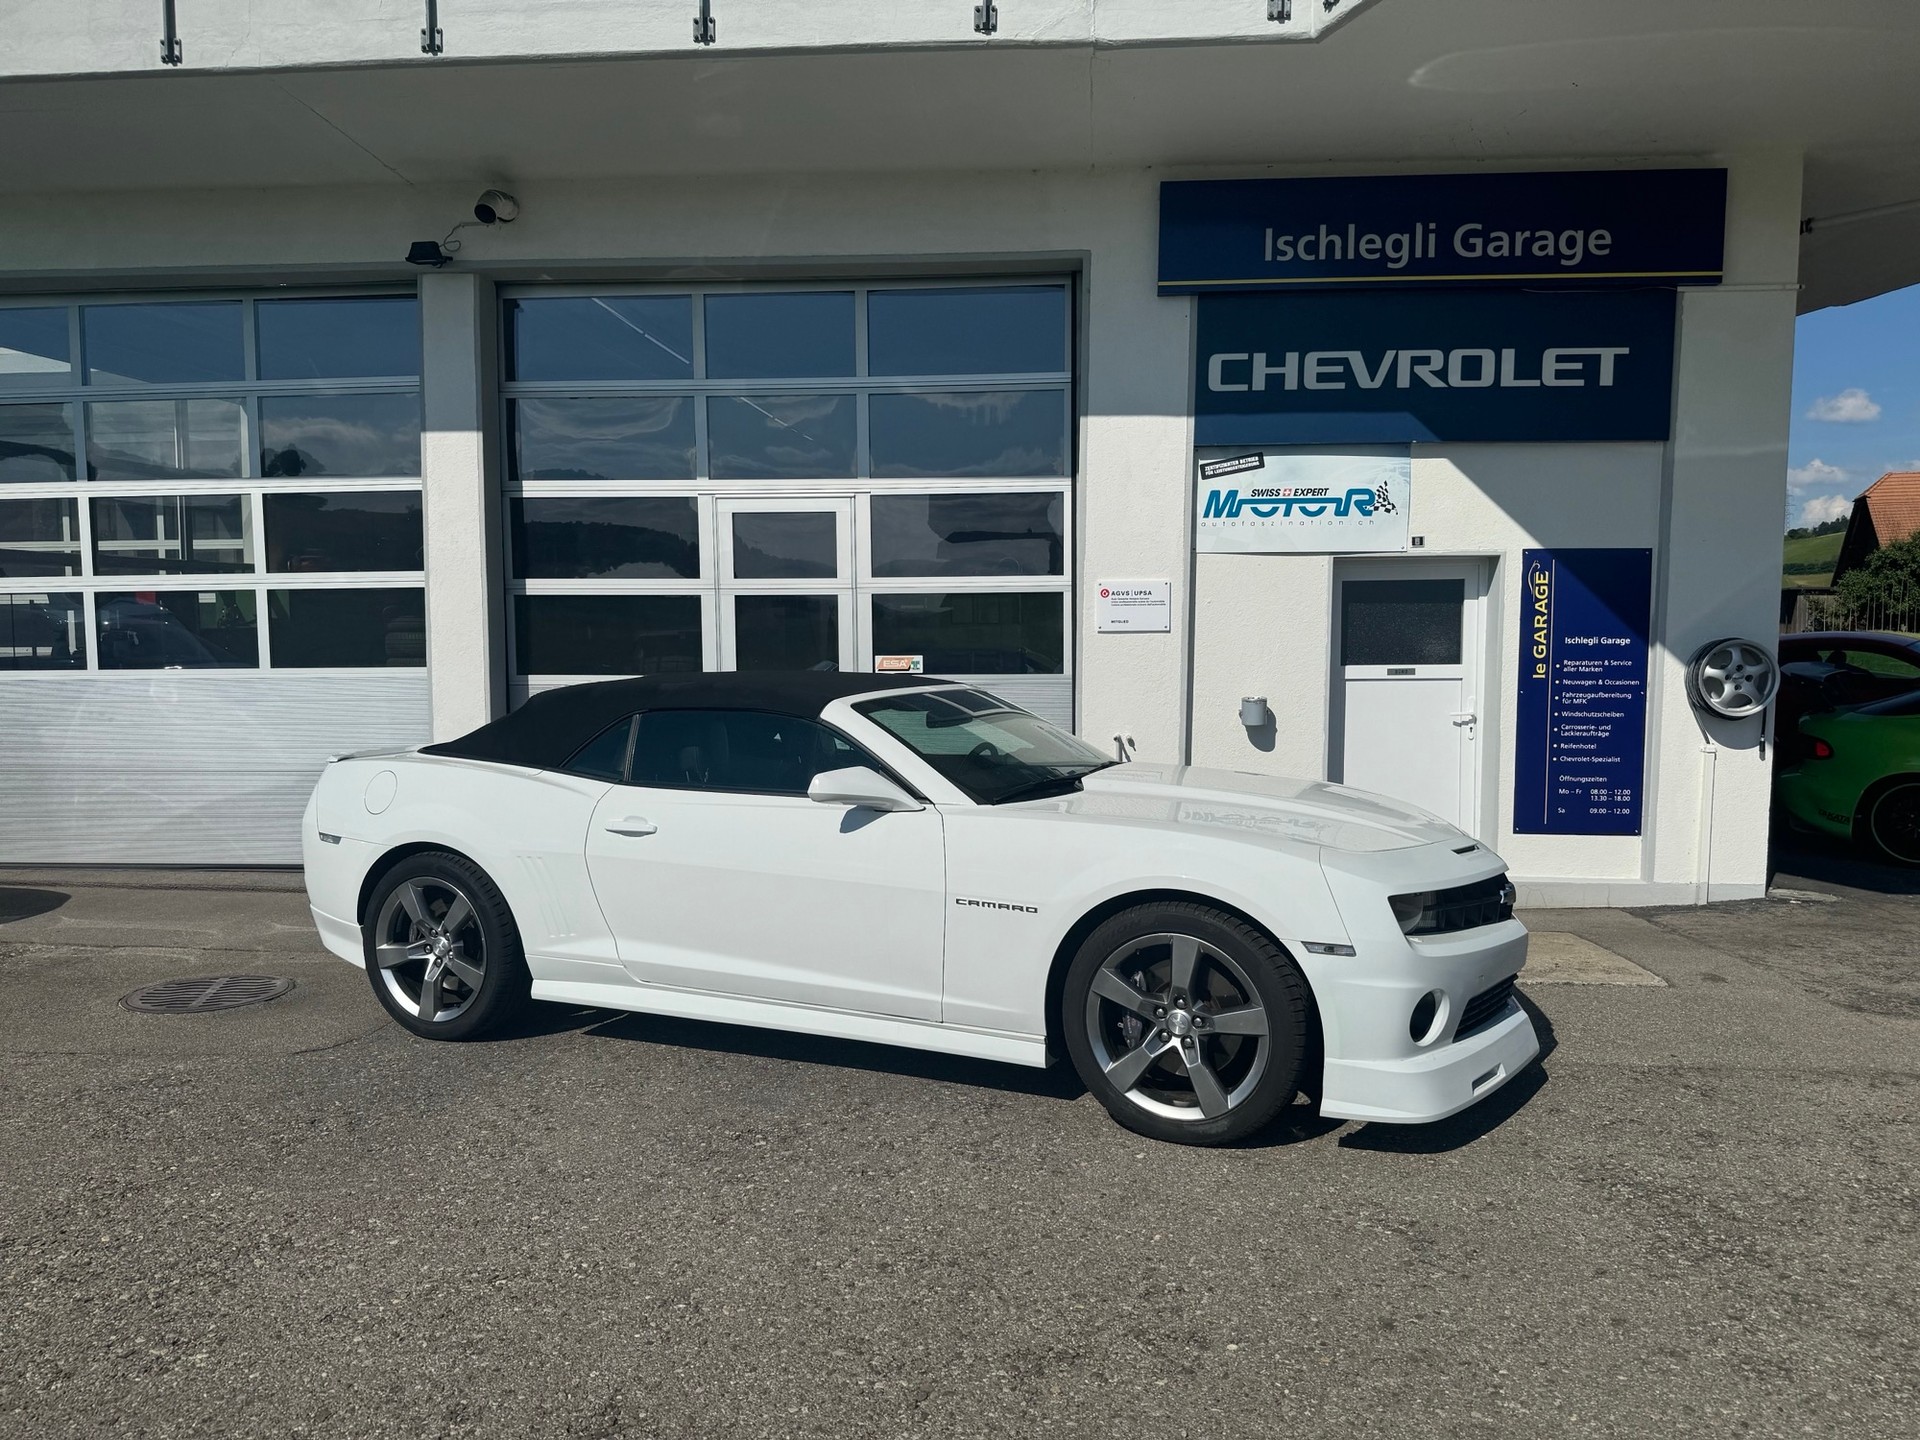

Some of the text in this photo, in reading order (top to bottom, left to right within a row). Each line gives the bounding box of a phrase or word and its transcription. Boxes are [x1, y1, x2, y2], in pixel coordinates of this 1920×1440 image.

[1264, 223, 1612, 269] Ischlegli Garage
[1207, 347, 1630, 392] CHEVROLET
[1251, 488, 1329, 497] SWISS EXPERT
[1532, 570, 1549, 679] le GARAGE
[1565, 636, 1631, 646] Ischlegli Garage
[883, 660, 906, 668] ESA
[1559, 775, 1607, 783] Öffnungszeiten
[1817, 807, 1850, 825] TAKATA
[955, 898, 1038, 914] CAMARO
